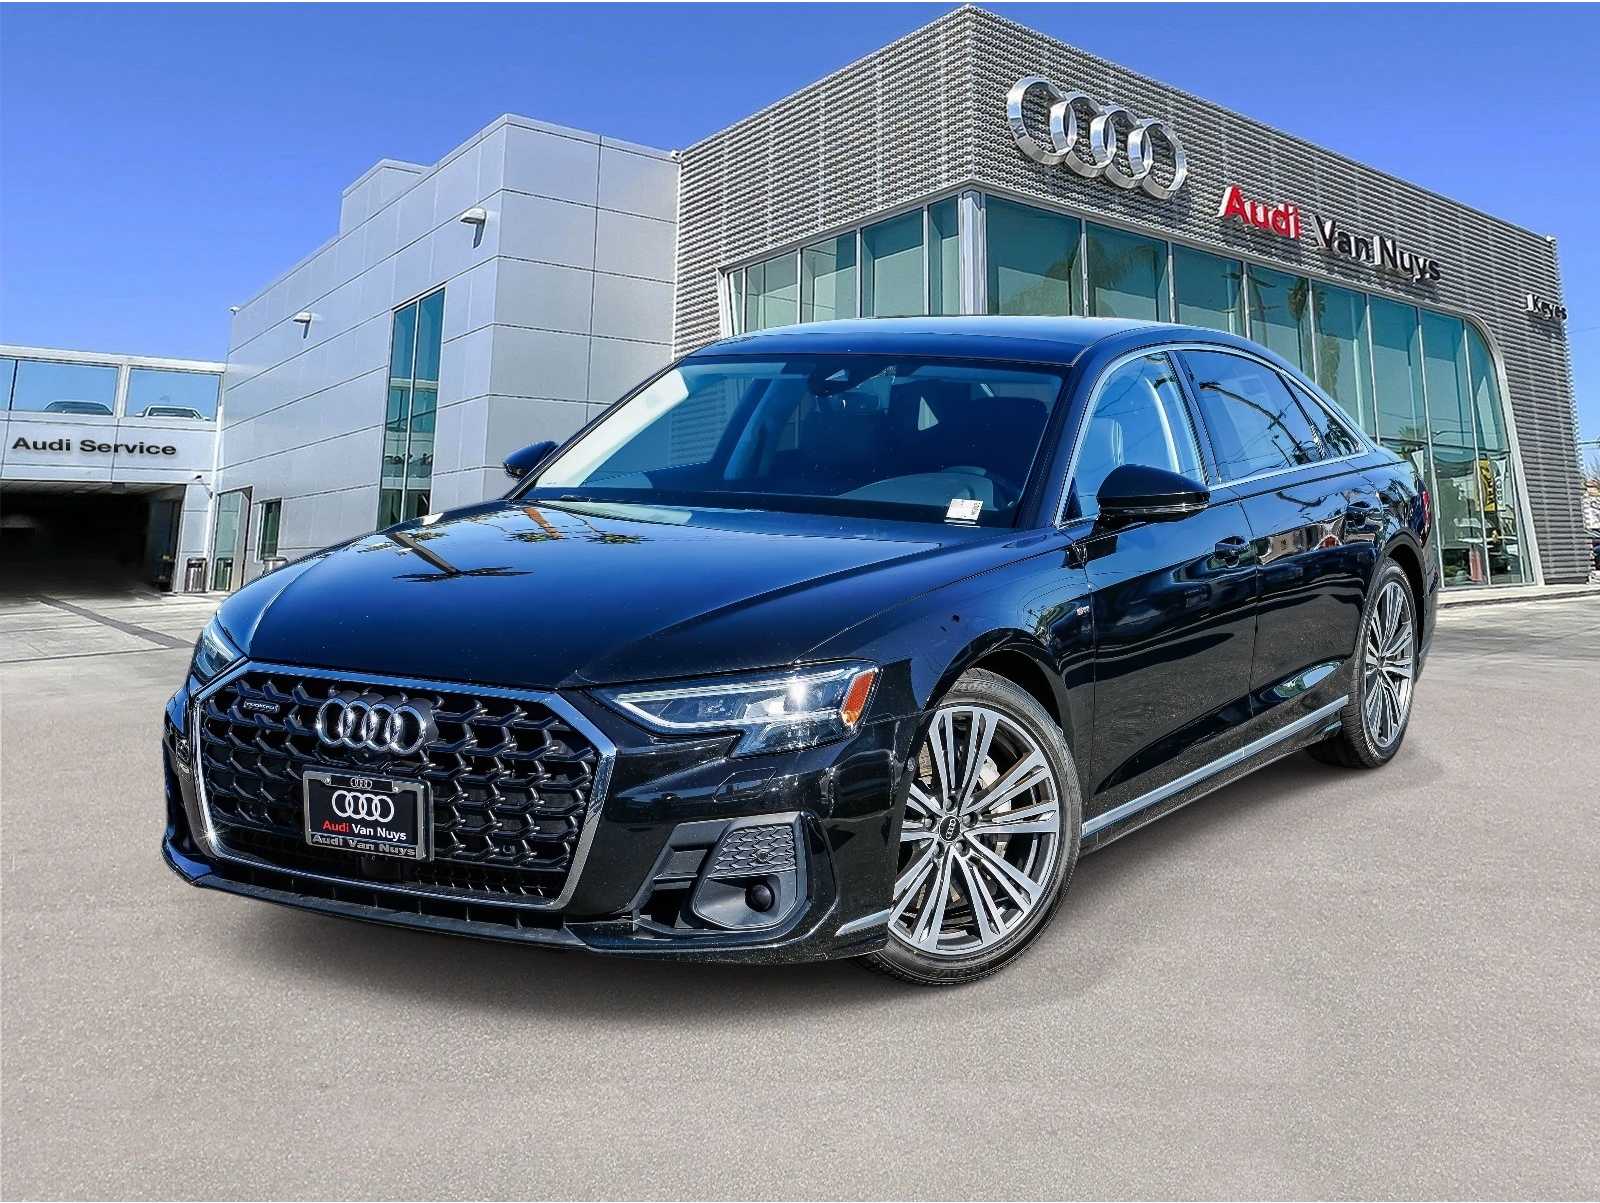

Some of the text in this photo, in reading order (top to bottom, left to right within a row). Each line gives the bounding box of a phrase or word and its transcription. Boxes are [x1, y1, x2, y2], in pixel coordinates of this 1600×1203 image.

[1216, 185, 1441, 282] Audi Van Nuys
[12, 437, 177, 455] Audi Service
[322, 820, 407, 841] Audi Van Nuys
[312, 834, 416, 856] Audi Van Nuys
